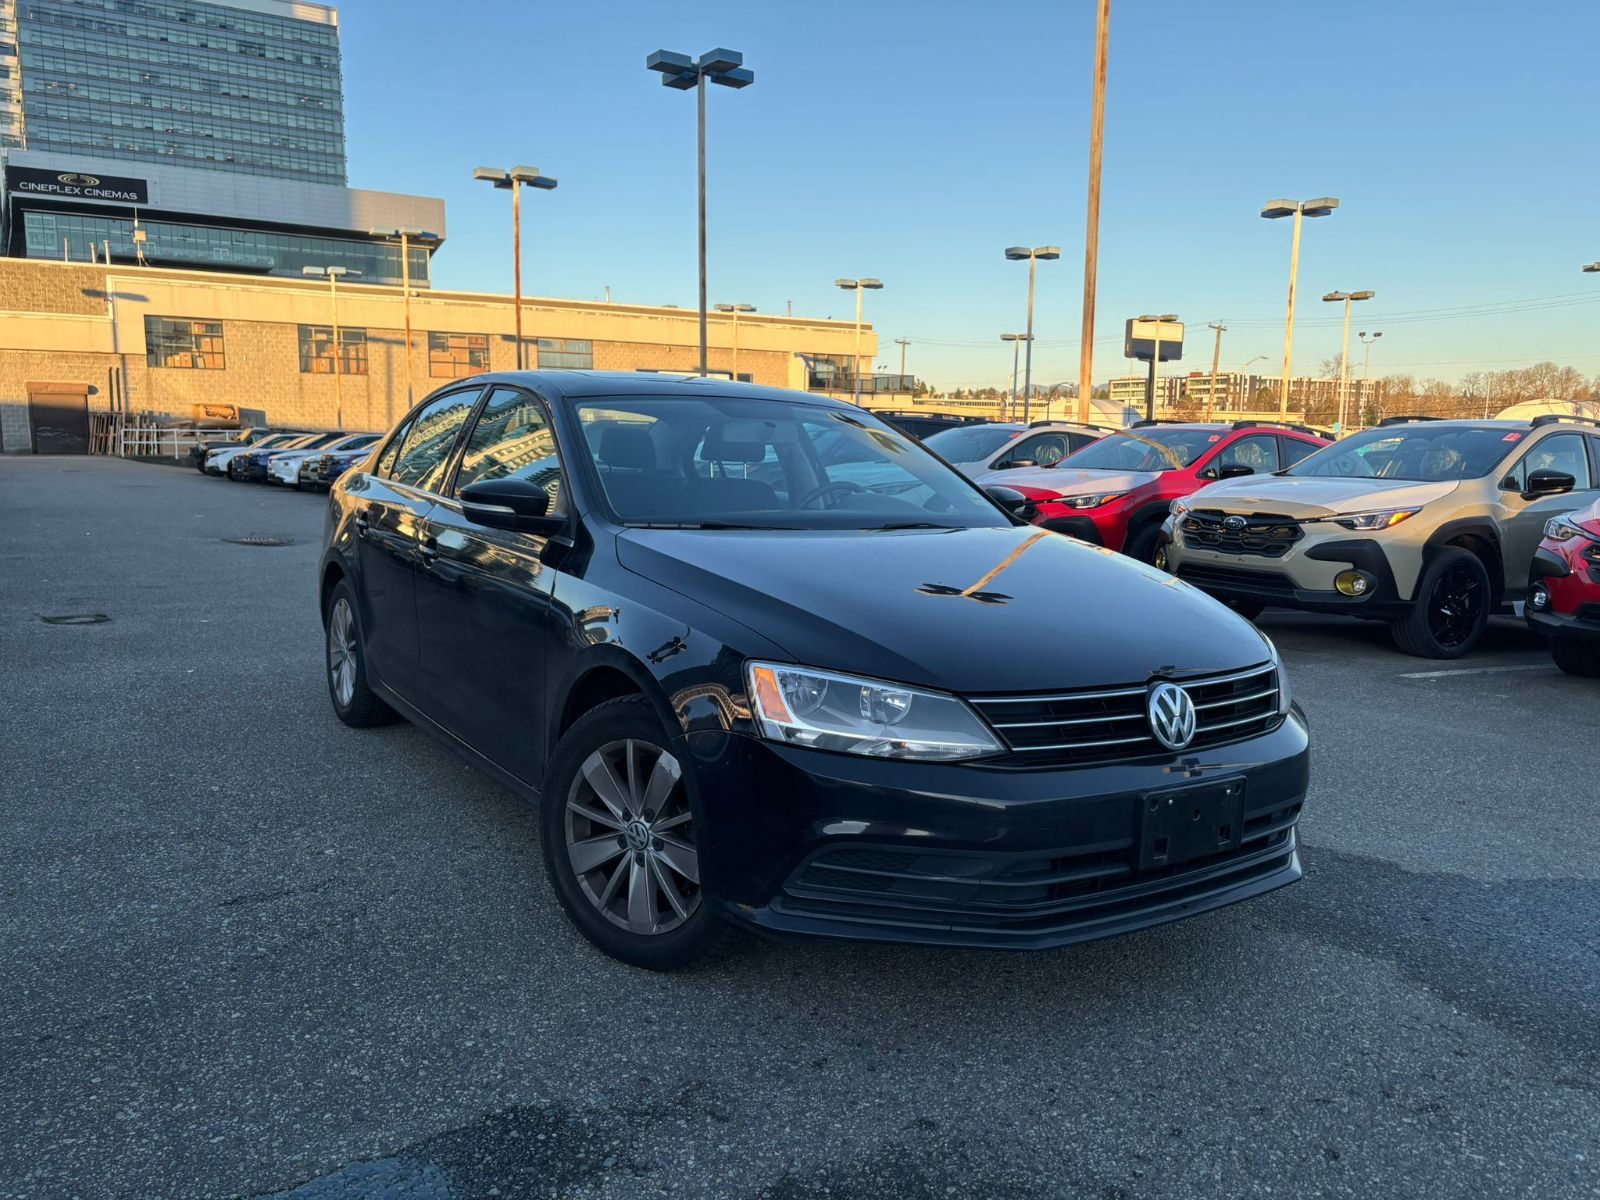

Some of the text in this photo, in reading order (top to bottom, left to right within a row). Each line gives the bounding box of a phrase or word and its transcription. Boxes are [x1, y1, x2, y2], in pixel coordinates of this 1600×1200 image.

[19, 181, 138, 200] CINEPLEX CINEMAS
[1150, 683, 1196, 749] VW
